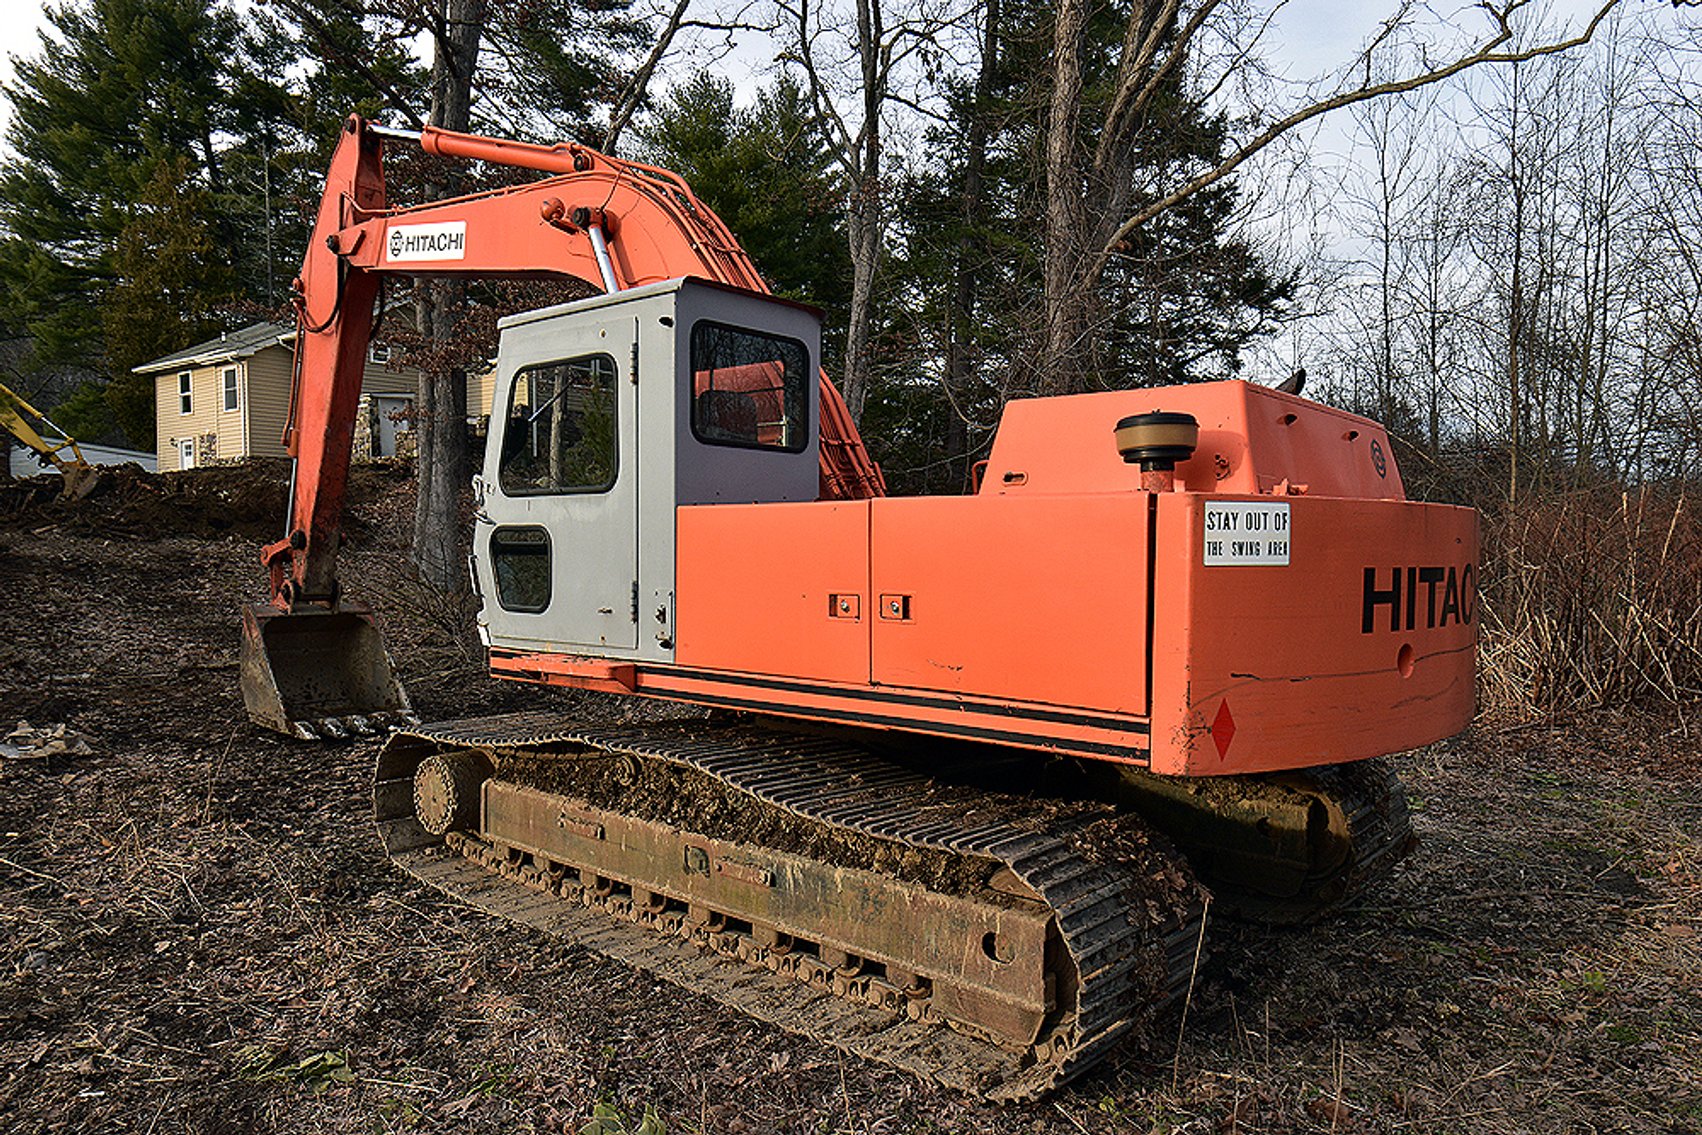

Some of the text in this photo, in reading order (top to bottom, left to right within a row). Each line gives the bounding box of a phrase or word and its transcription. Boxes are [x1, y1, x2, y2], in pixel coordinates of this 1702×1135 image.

[405, 233, 464, 252] HITACHI
[1207, 511, 1288, 531] STAY OUT OF
[1207, 541, 1223, 556] THE
[1232, 541, 1260, 556] SWING
[1361, 563, 1476, 634] HITAC
